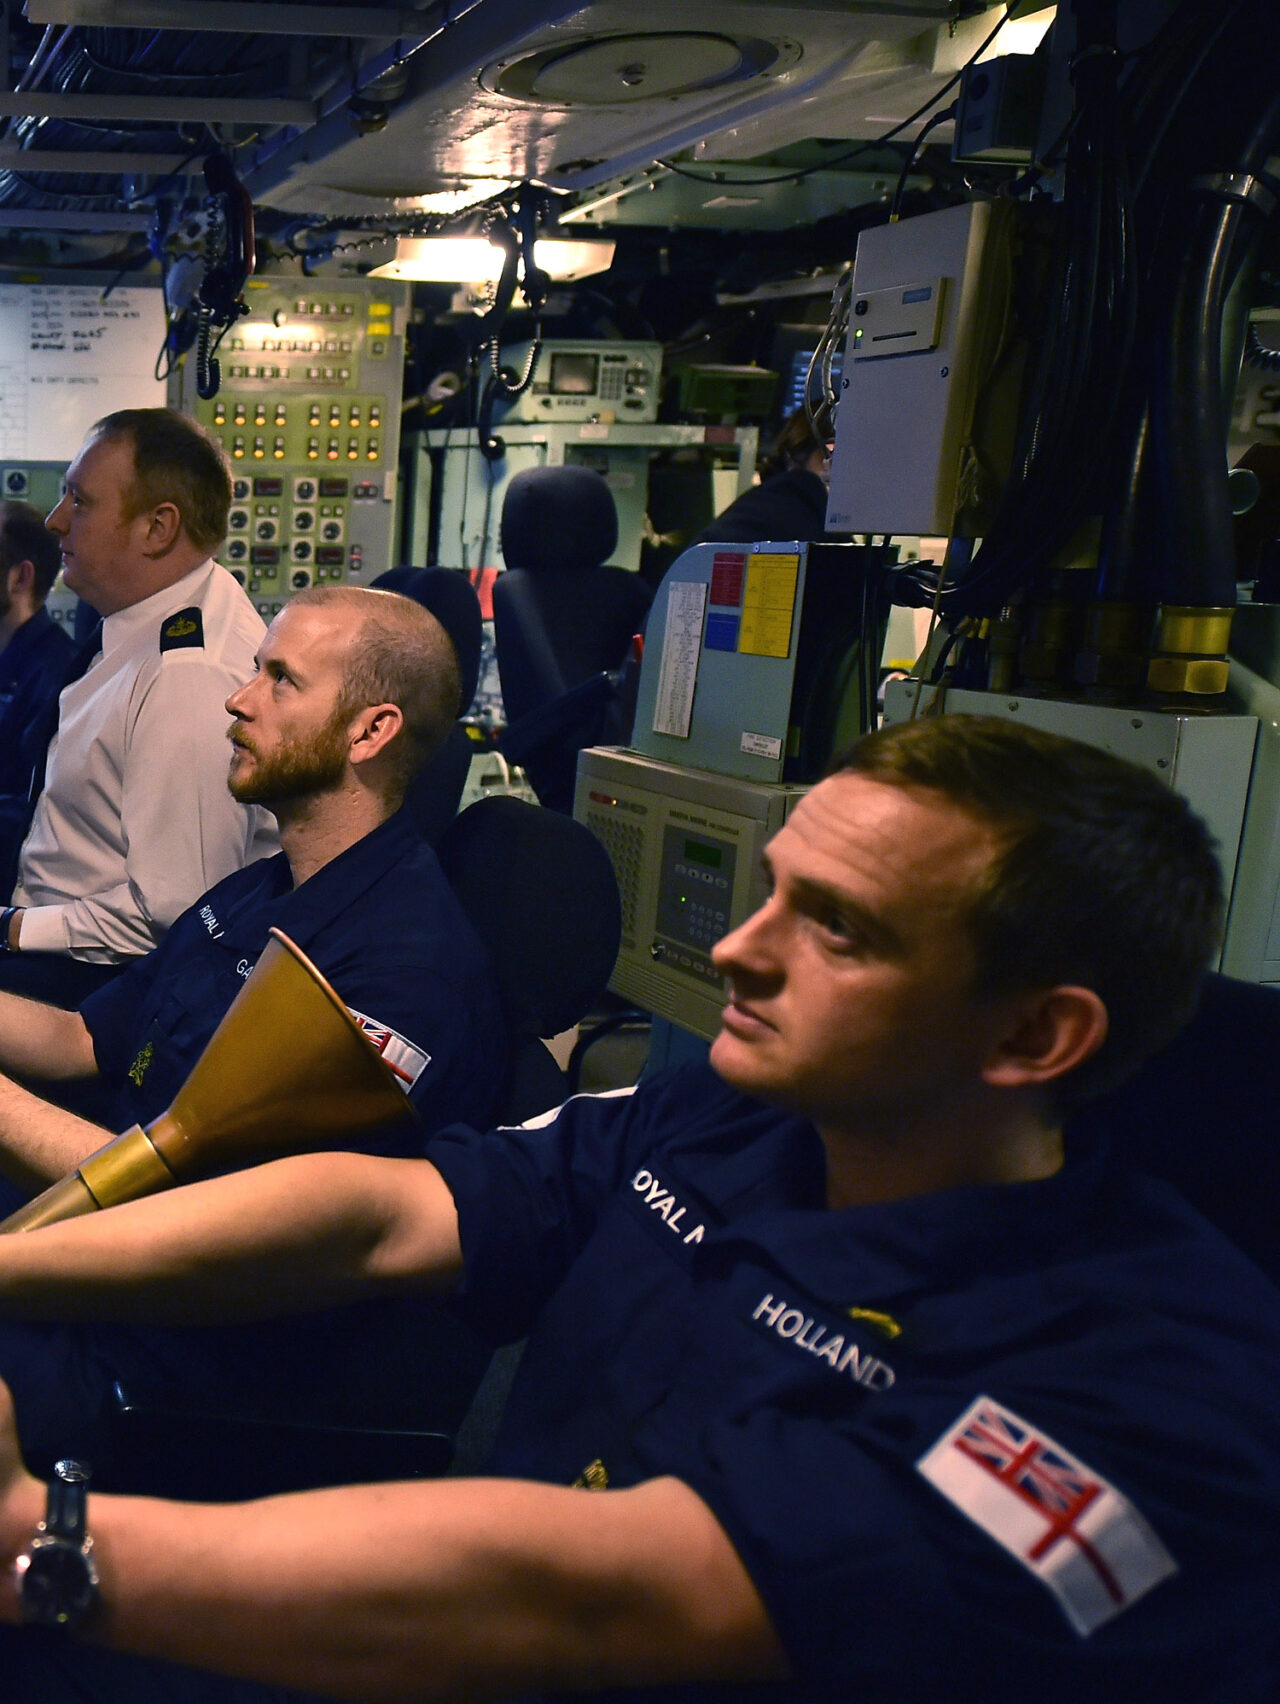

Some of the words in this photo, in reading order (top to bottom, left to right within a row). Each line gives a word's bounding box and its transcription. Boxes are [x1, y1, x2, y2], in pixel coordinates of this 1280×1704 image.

[199, 904, 219, 934] ROYAL
[236, 958, 254, 980] GA
[631, 1168, 680, 1233] OYAL
[752, 1293, 896, 1391] HOLLAND
